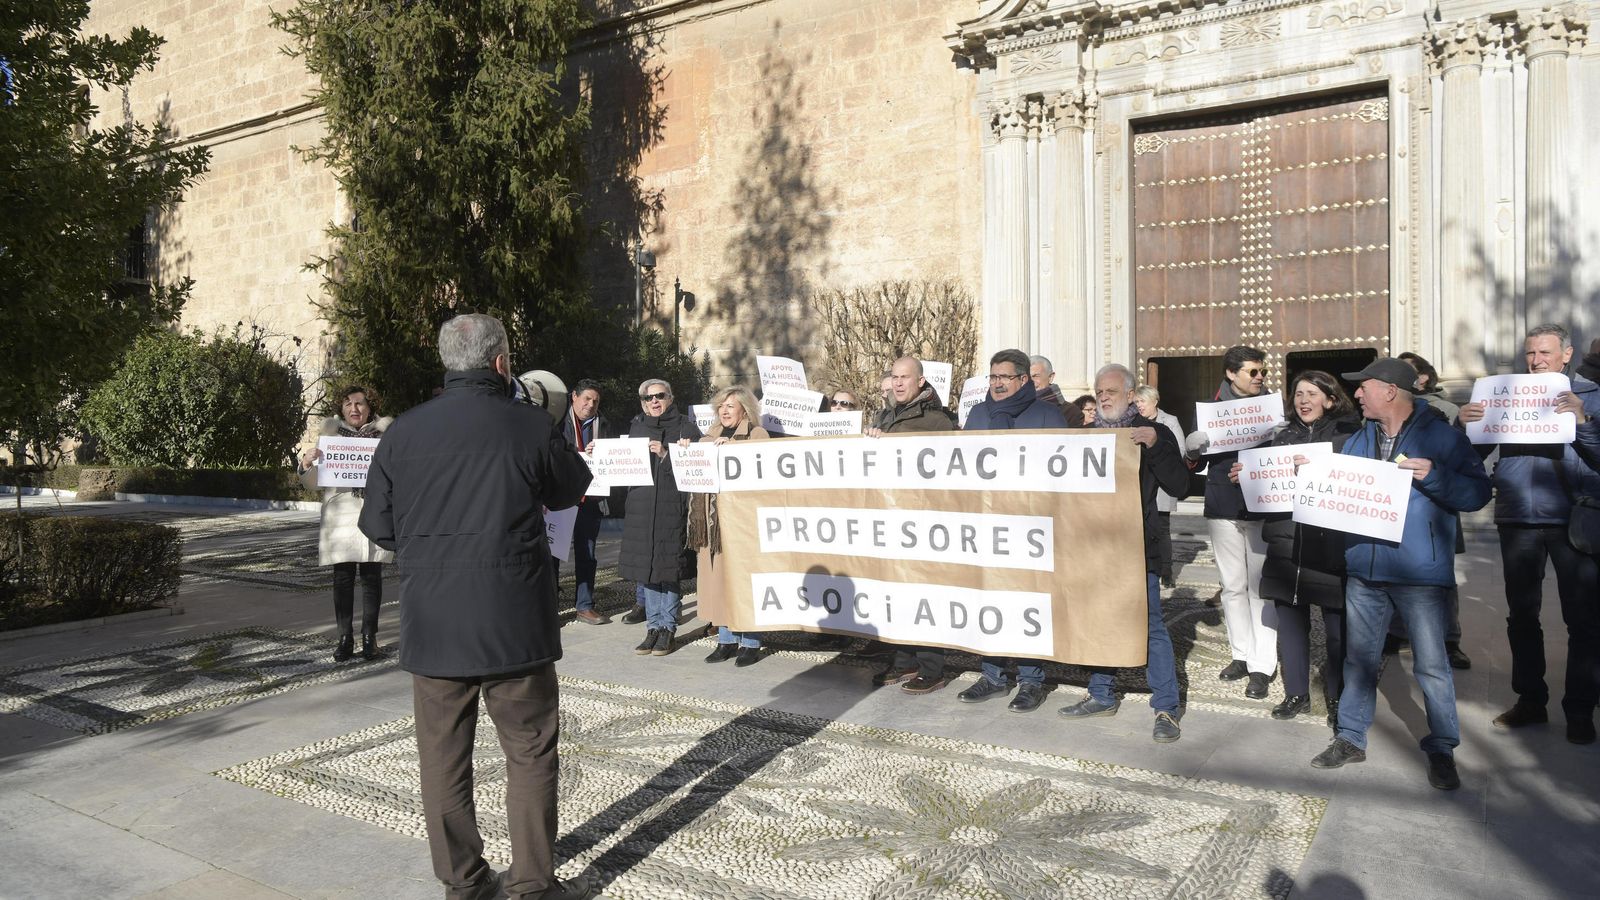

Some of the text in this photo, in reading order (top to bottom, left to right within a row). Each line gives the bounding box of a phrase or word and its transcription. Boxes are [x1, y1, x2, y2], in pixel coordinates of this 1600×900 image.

[1494, 385, 1548, 396] LA LOSU
[765, 399, 814, 413] DEDICACIÓN
[1480, 398, 1559, 408] DISCRIMINA
[1217, 405, 1261, 418] LA LOSU
[1501, 411, 1539, 421] A LOS
[774, 418, 802, 428] GESTIÓN
[1207, 414, 1273, 428] DISCRIMINA
[1226, 427, 1257, 437] A LOS
[1483, 424, 1559, 434] ASOCIADOS
[327, 444, 376, 453] RECONOCIMIE
[1259, 456, 1292, 467] LA LO
[608, 467, 648, 475] ASOCIADOS
[1328, 469, 1375, 486] APOYO
[1271, 481, 1296, 491] A LO
[1306, 481, 1392, 506] A LA HUELGA
[1257, 494, 1292, 504] ASOCI
[1300, 494, 1399, 522] DE ASOCIADOS
[766, 517, 1045, 559] PROFESORES
